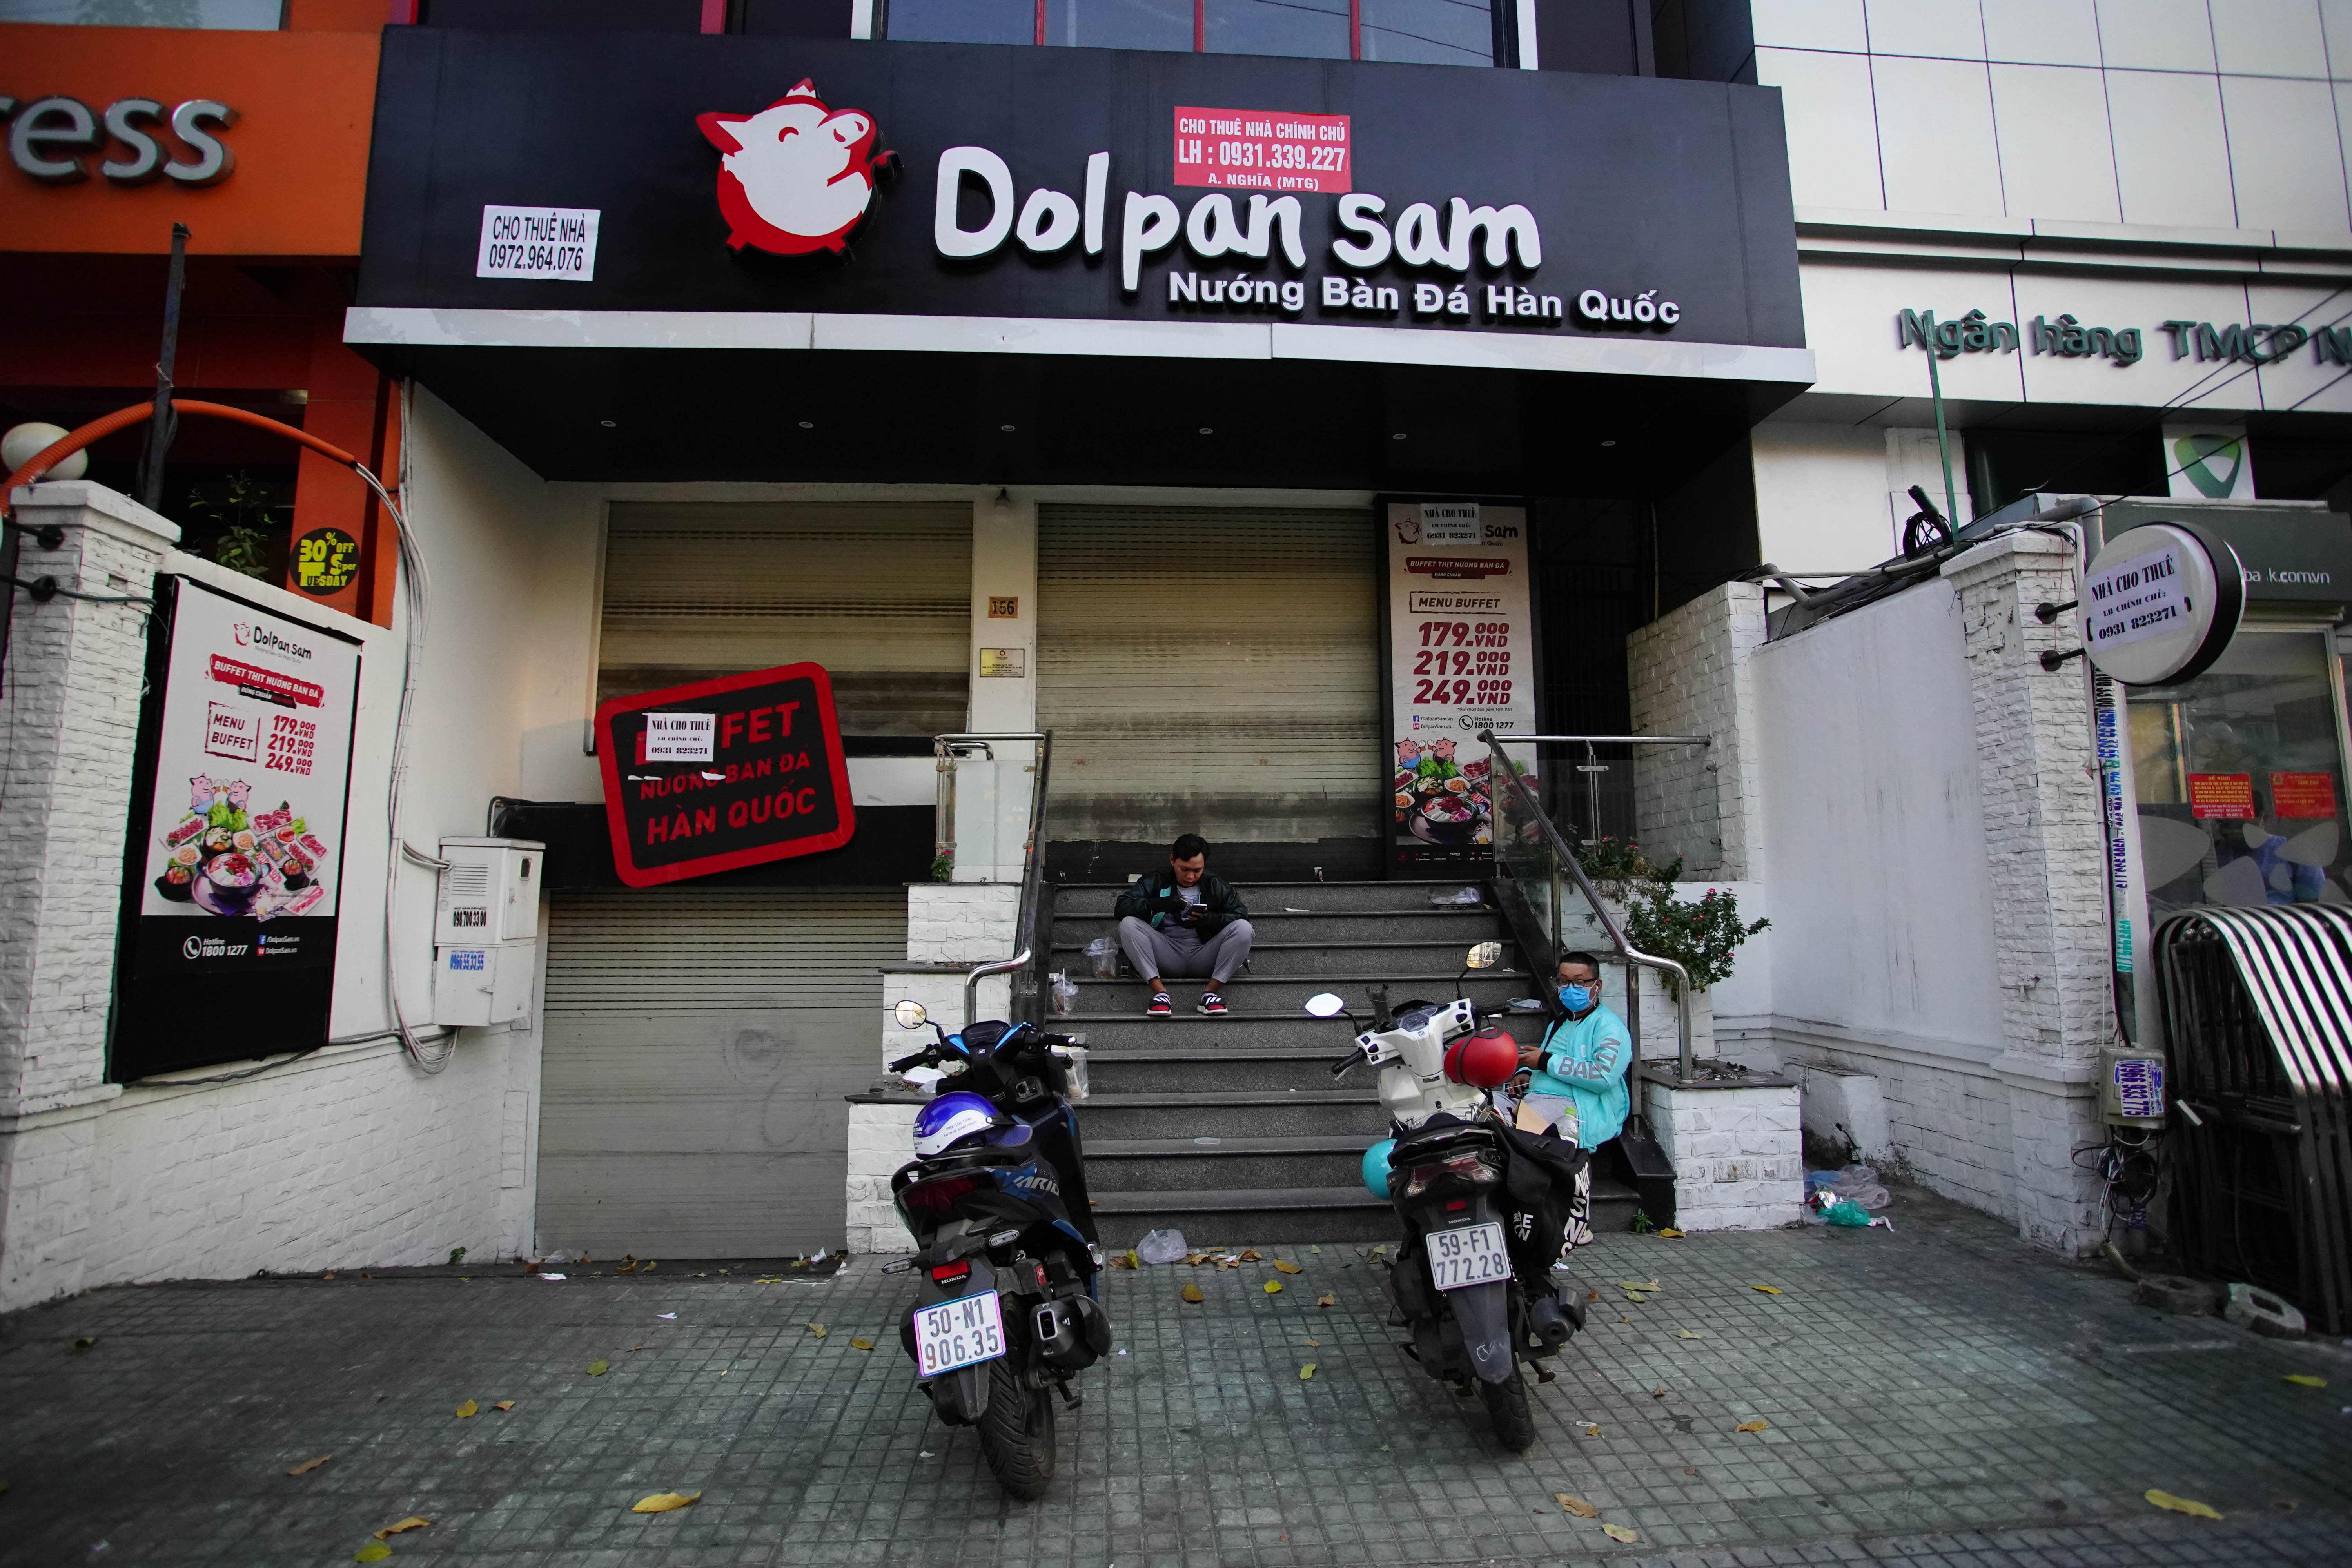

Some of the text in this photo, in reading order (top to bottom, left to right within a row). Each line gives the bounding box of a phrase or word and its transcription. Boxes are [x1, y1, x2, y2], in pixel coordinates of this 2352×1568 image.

[1180, 118, 1345, 142] CHO THUÊ NHÀ CHÍNH CHỦ
[1179, 139, 1201, 164] LH
[1219, 141, 1345, 171] 0931.339.227
[1208, 173, 1319, 191] A. NGHĨA (MTG)
[493, 212, 585, 243] CHO THUÊ NHÀ
[489, 244, 583, 271] 0972.964.076
[1168, 272, 1680, 325] Nướng Bàn Đá Hàn Quốc
[1899, 309, 2018, 358] Ngân
[2034, 314, 2142, 366] hàng
[2162, 319, 2307, 364] TMCP
[1424, 506, 1476, 519] NHÀ CHO THUÊ
[336, 543, 355, 553] OFF
[1480, 560, 1494, 568] BÀN
[2091, 554, 2175, 602] NHÀ CHO THUÊ
[992, 600, 1014, 615] 156
[1419, 597, 1501, 608] MENU BUFFET
[2103, 607, 2114, 617] LH
[2115, 598, 2142, 613] CHÍNH
[2098, 605, 2178, 640] 0931 823271
[1474, 635, 1508, 647] VND
[1476, 664, 1509, 676] VND
[214, 661, 319, 699] BUFFET THỊT NƯỚNG BÀN ĐÁ
[1477, 692, 1510, 705] VND
[213, 713, 245, 730] MENU
[652, 717, 711, 731] NHÀ CHO THUÊ
[211, 732, 254, 750] BUFFET
[299, 728, 314, 739] VND
[297, 747, 312, 757] VND
[295, 765, 310, 776] VND
[647, 779, 816, 845] HÀN QUỐC
[201, 946, 225, 956] 1800
[227, 945, 248, 956] 1277
[2119, 1063, 2150, 1116] 0966.933.775
[1438, 1228, 1490, 1258] 59-F1
[1436, 1252, 1504, 1285] 772.28
[941, 1274, 967, 1285] HONDA
[927, 1298, 984, 1338] 50-N1
[924, 1324, 999, 1370] 906.35
